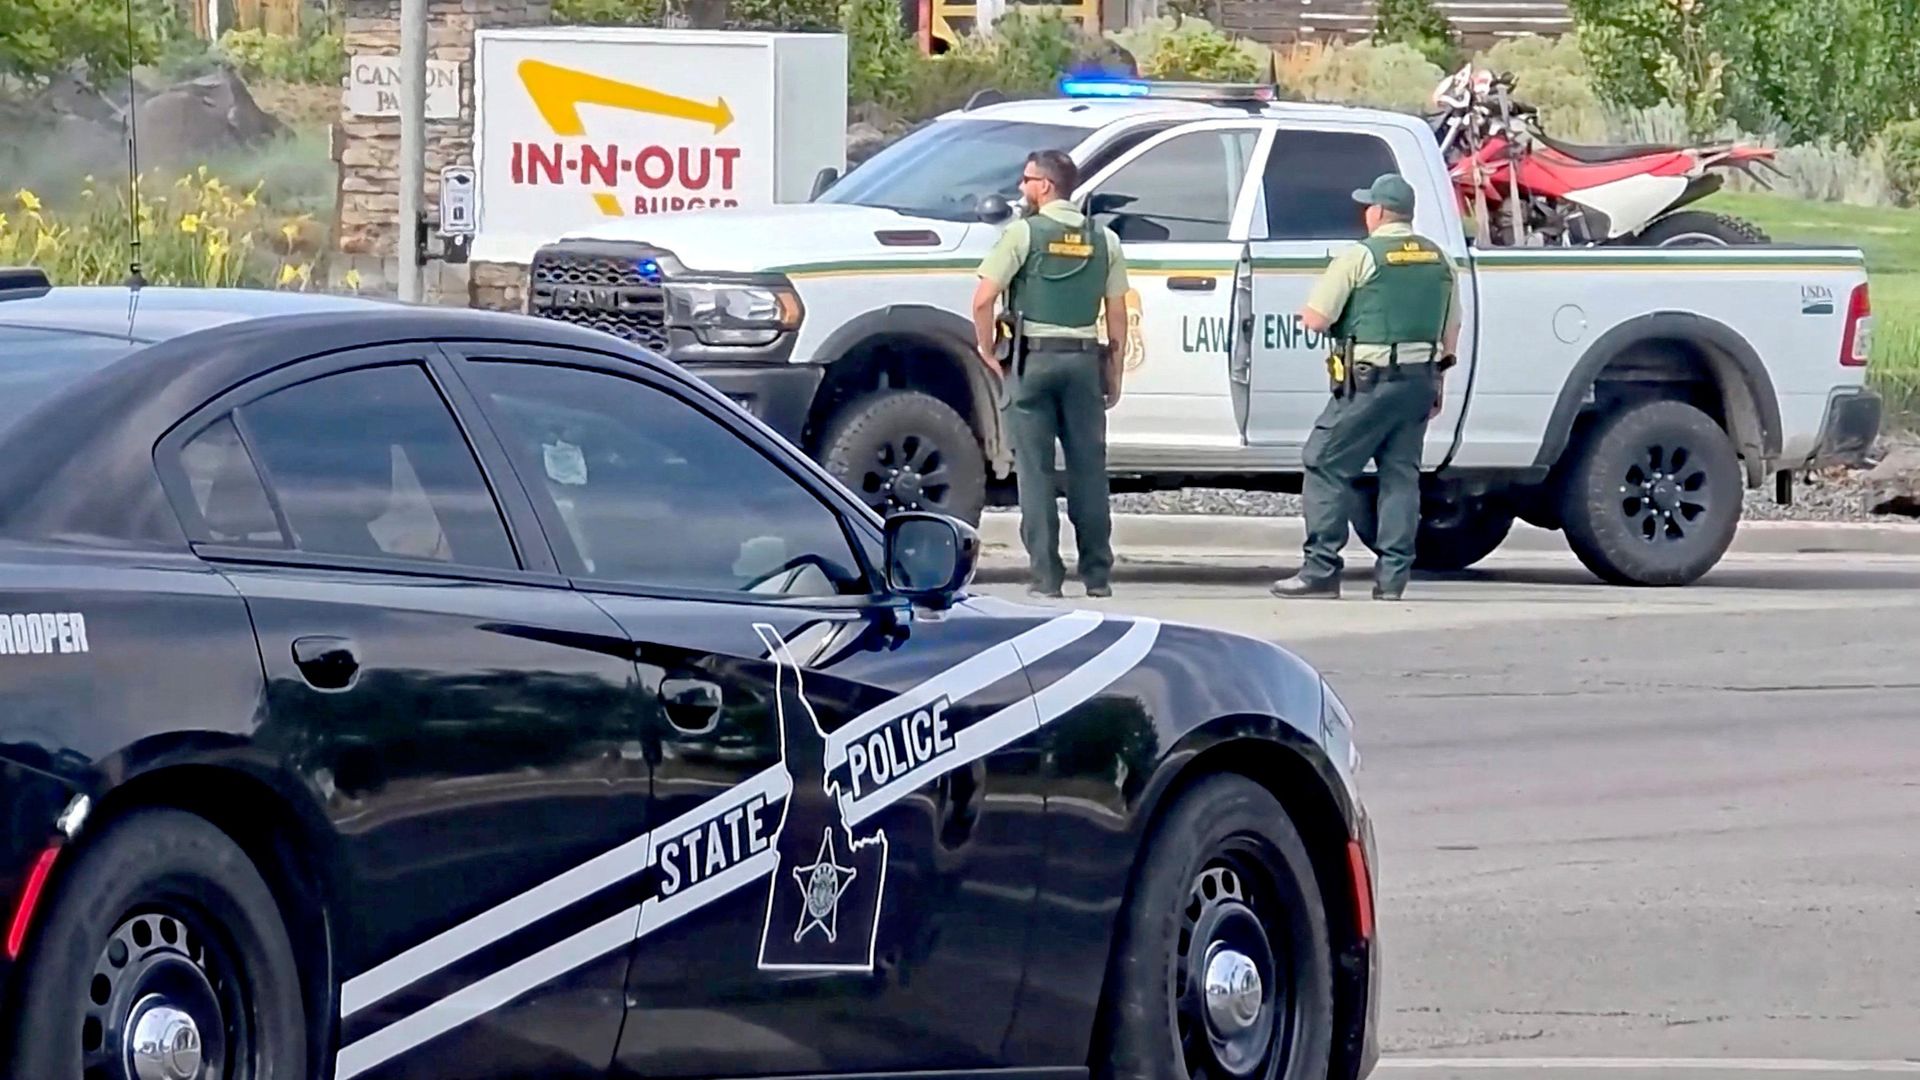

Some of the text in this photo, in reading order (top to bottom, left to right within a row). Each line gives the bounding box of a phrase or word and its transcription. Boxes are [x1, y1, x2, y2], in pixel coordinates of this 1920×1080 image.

[356, 64, 454, 88] CANON
[376, 91, 432, 111] PAK
[1801, 284, 1833, 298] USDA
[1182, 315, 1236, 352] LAW
[848, 701, 953, 797] POLICE
[661, 797, 767, 895] STATE
